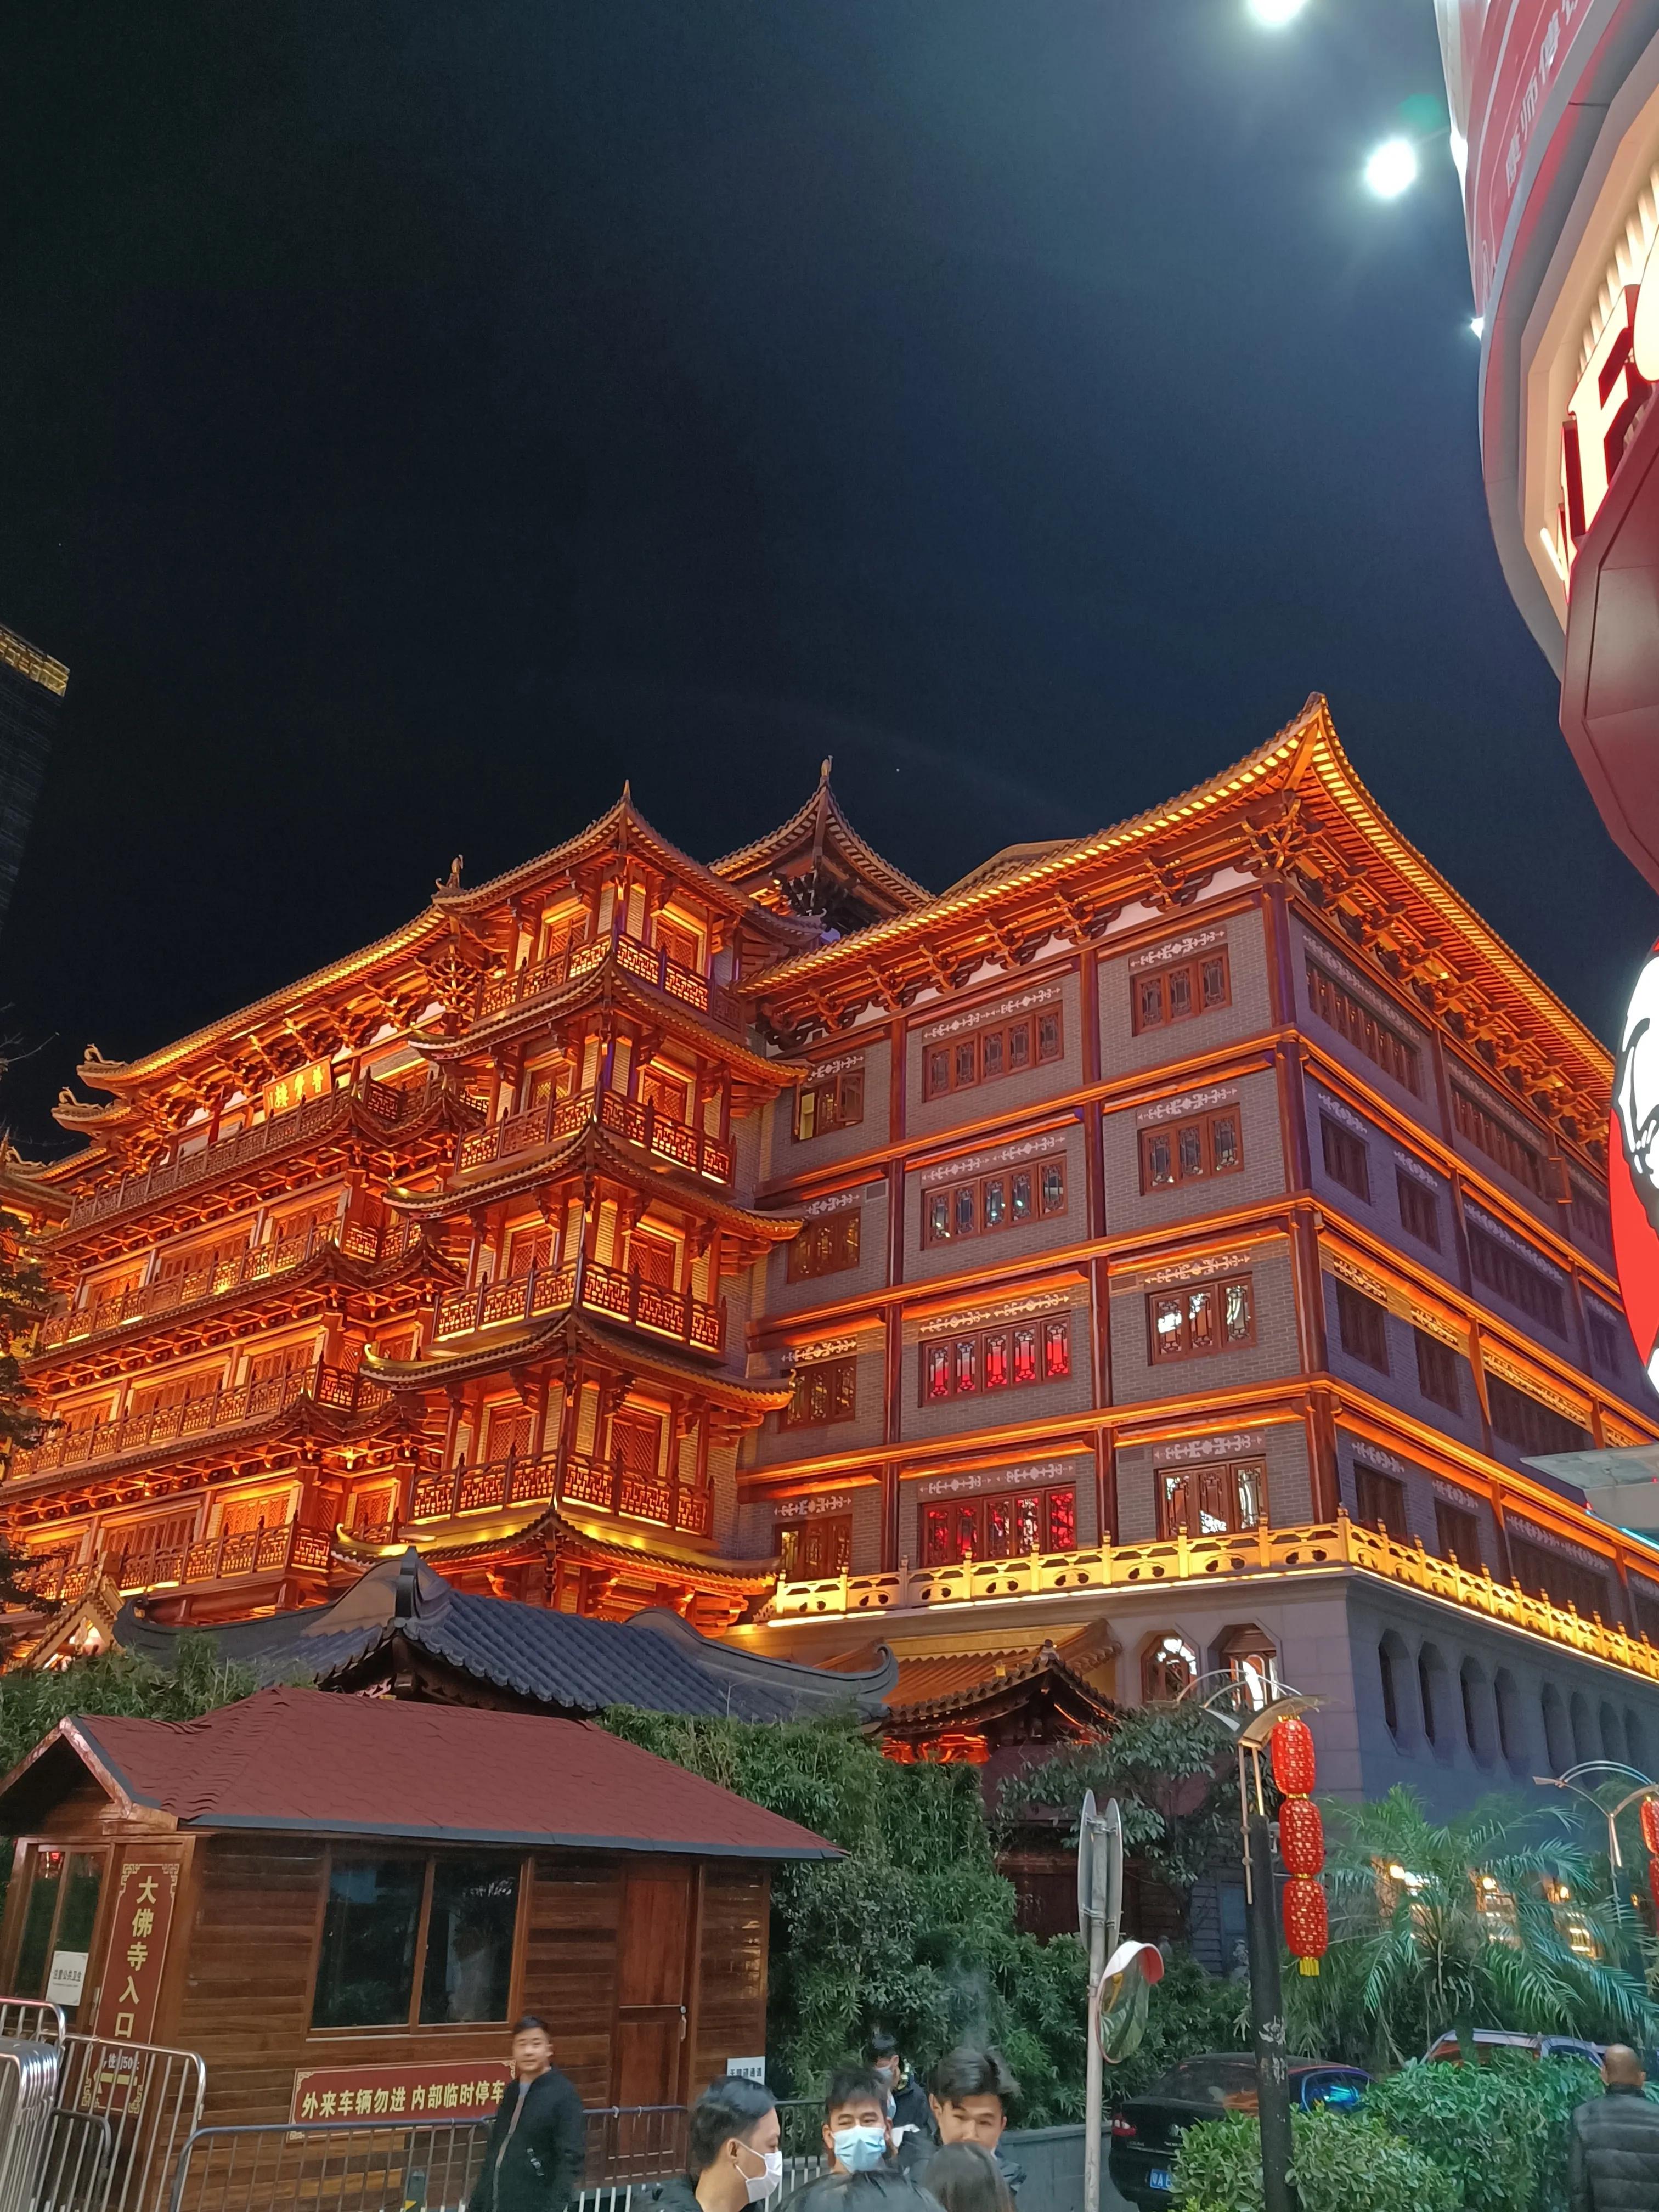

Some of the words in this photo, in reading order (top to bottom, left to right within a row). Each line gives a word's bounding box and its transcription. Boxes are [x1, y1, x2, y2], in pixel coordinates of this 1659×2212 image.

[1506, 0, 1578, 197] 康师傅
[114, 1876, 159, 2038] 大佛寺入口
[301, 2086, 406, 2119] 外来车辆勿进
[411, 2080, 505, 2111] 内部临时停车
